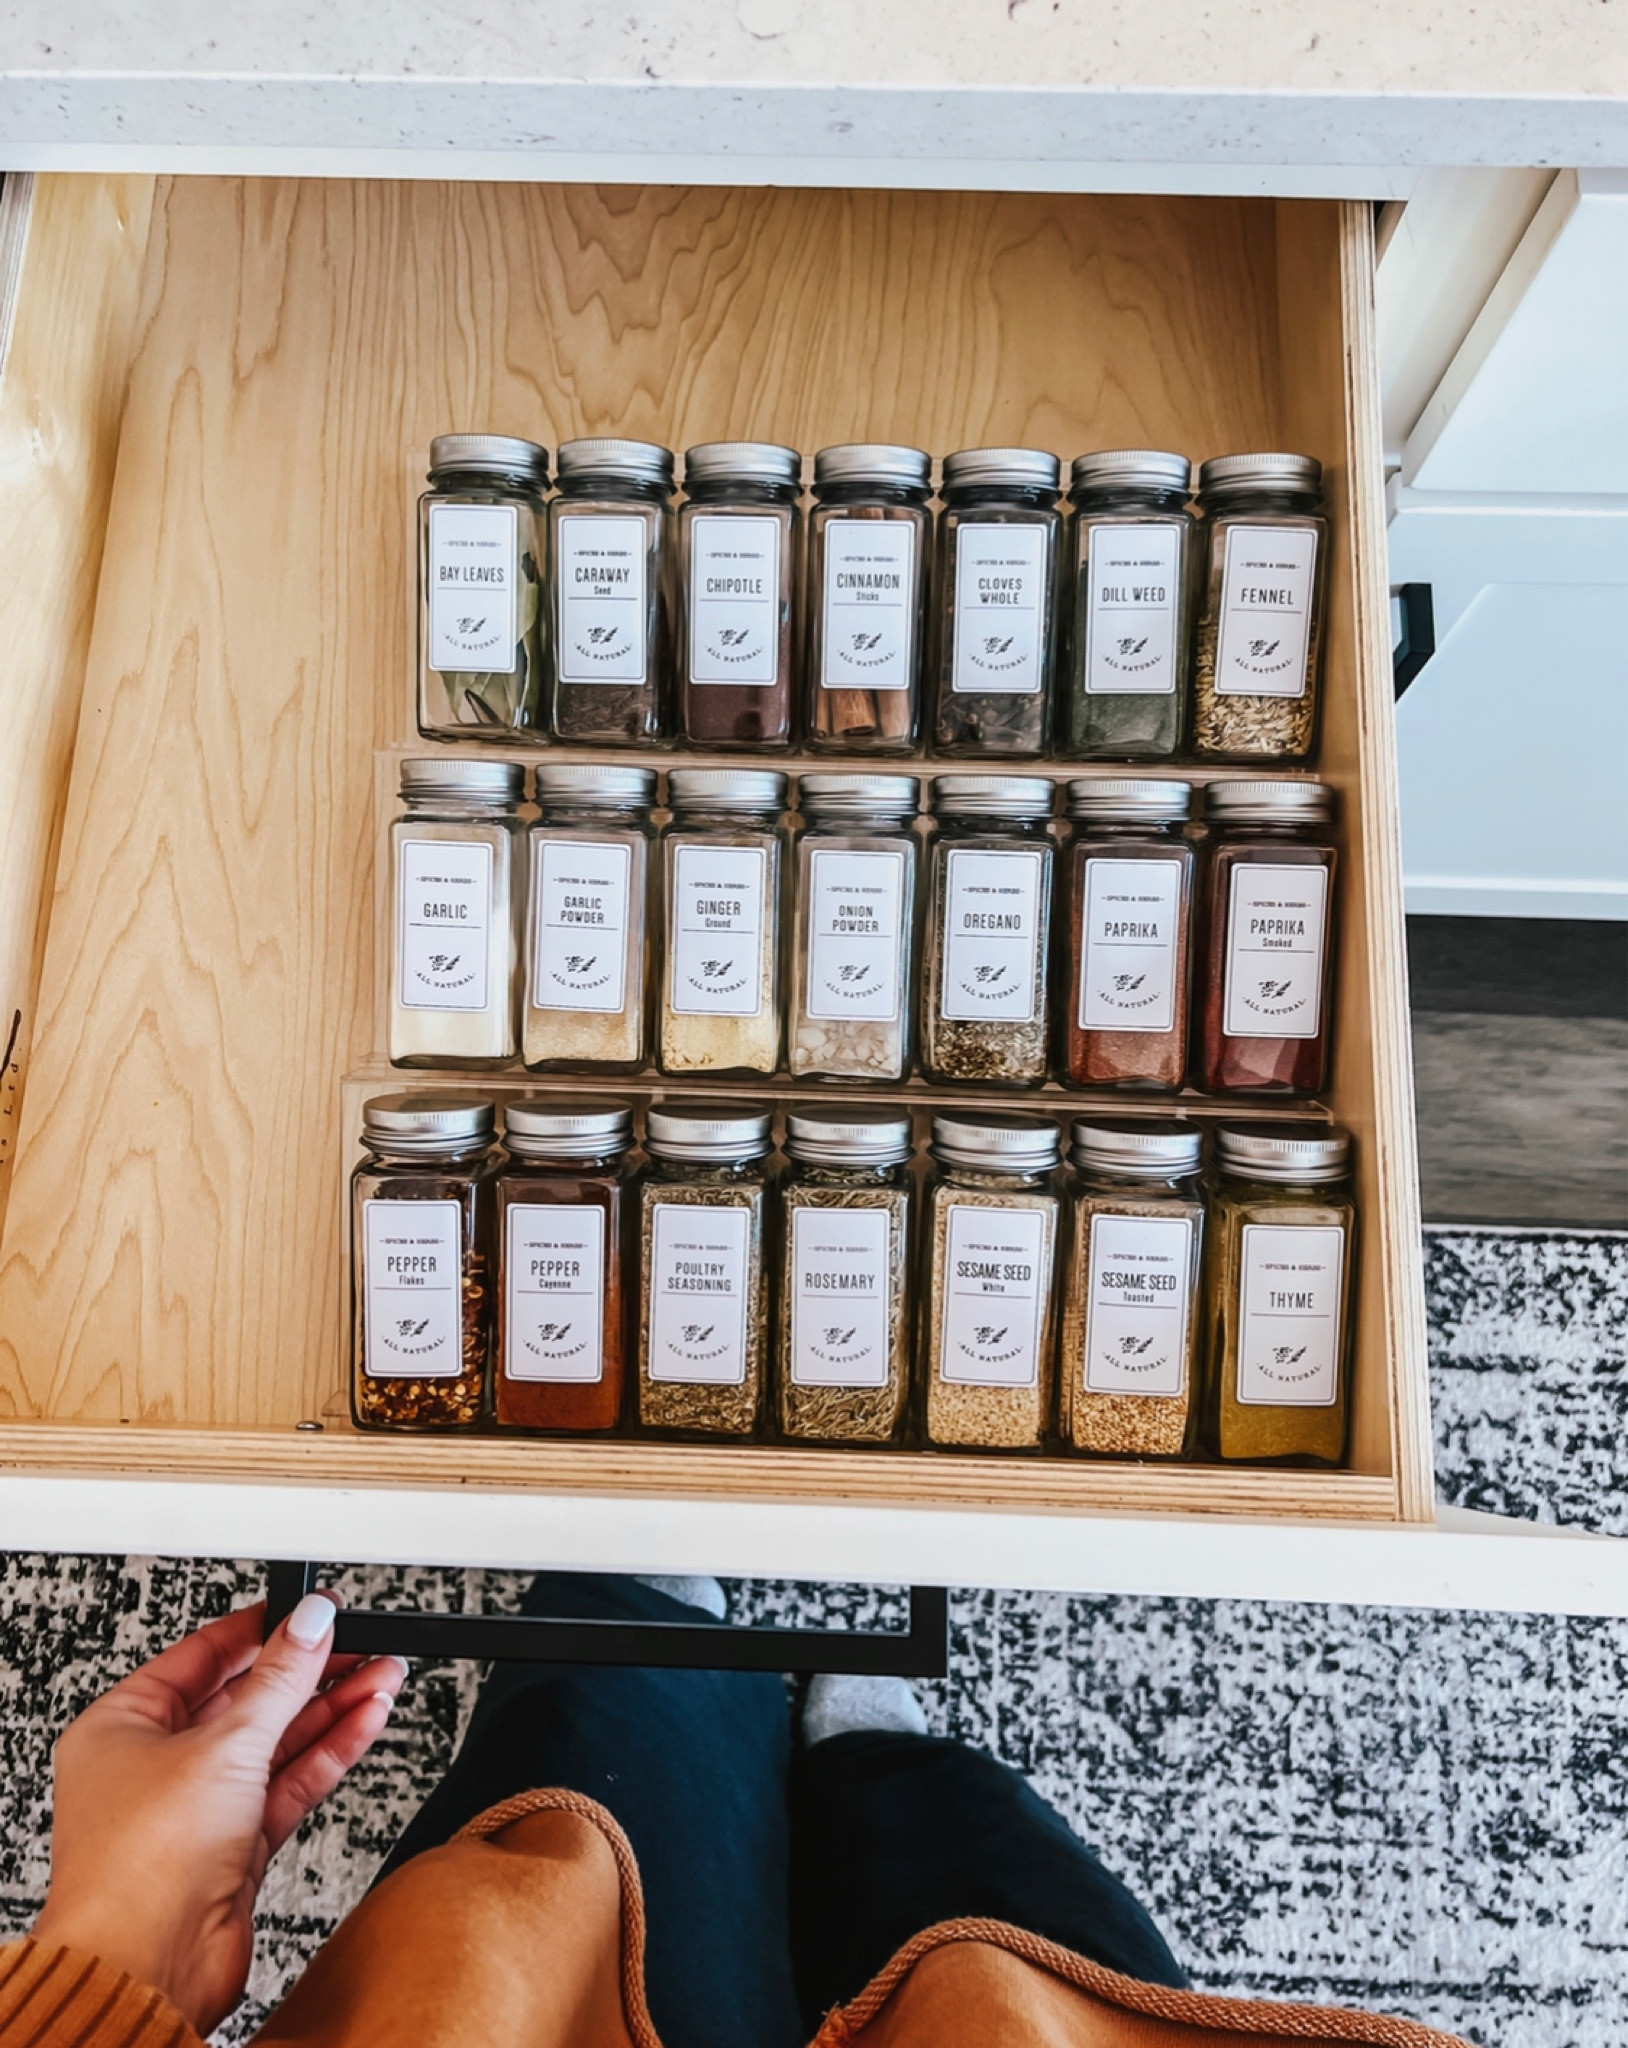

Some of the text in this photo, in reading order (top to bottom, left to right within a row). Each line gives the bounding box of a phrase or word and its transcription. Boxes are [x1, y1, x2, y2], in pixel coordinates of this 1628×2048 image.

[440, 566, 504, 582] BAY LEAVES
[575, 568, 630, 583] CARAWAY
[837, 573, 900, 589] CINNAMON
[594, 585, 611, 595] Seed
[707, 578, 762, 594] CHIPOTLE
[979, 578, 1022, 590] CLOVES
[856, 592, 879, 601] Sticks
[981, 593, 1020, 604] WHOLE
[1102, 588, 1165, 602] DILL WEED
[1240, 588, 1293, 605] FENNEL
[564, 896, 601, 909] GARLIC
[697, 900, 741, 915] GINGER
[424, 903, 467, 919] GARLIC
[561, 910, 604, 924] POWDER
[839, 905, 873, 917] ONION
[705, 918, 731, 928] Ground
[833, 920, 879, 932] POWDER
[964, 913, 1021, 930] OREGANO
[1250, 919, 1305, 935] PAPRIKA
[1105, 923, 1157, 938] PAPRIKA
[1263, 938, 1292, 947] Smoked
[388, 1257, 436, 1272] PEPPER
[531, 1260, 579, 1276] PEPPER
[676, 1262, 724, 1276] POULTRY
[957, 1261, 1031, 1281] SESAME SEED
[399, 1276, 424, 1285] Flakes
[539, 1279, 571, 1289] Cayenne
[668, 1277, 731, 1291] SEASONING
[805, 1273, 875, 1289] ROSEMARY
[983, 1283, 1005, 1292] White
[1102, 1272, 1176, 1290] SESAME SEED
[1123, 1292, 1154, 1302] Toasted
[1270, 1292, 1314, 1308] THYME
